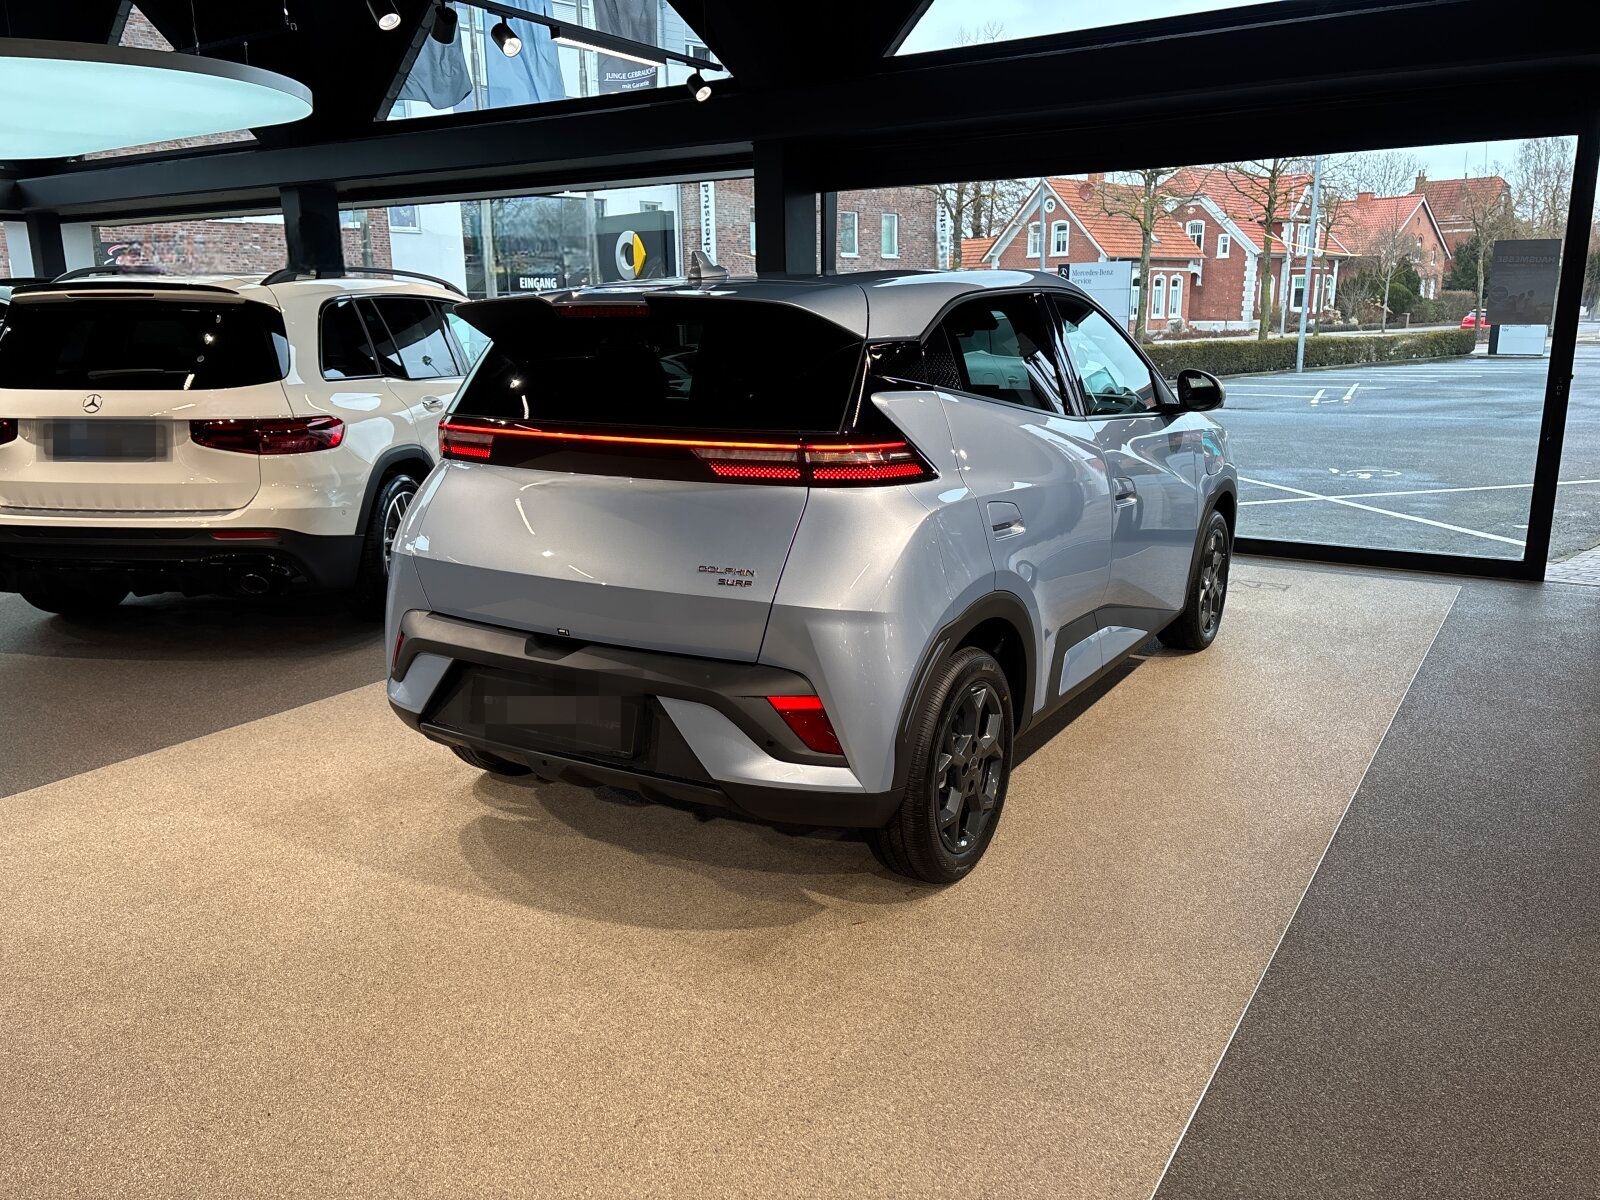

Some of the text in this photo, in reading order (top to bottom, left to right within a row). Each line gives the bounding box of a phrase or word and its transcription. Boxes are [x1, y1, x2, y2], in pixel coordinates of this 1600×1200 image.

[605, 72, 627, 80] JUNGE
[631, 80, 650, 88] Garantie
[701, 183, 711, 257] chenstud
[1072, 269, 1114, 277] Mercedes-Benz
[519, 277, 557, 289] EINGANG
[1072, 277, 1092, 285] Service
[698, 565, 755, 577] DOLPHIN
[717, 578, 753, 588] SURF
